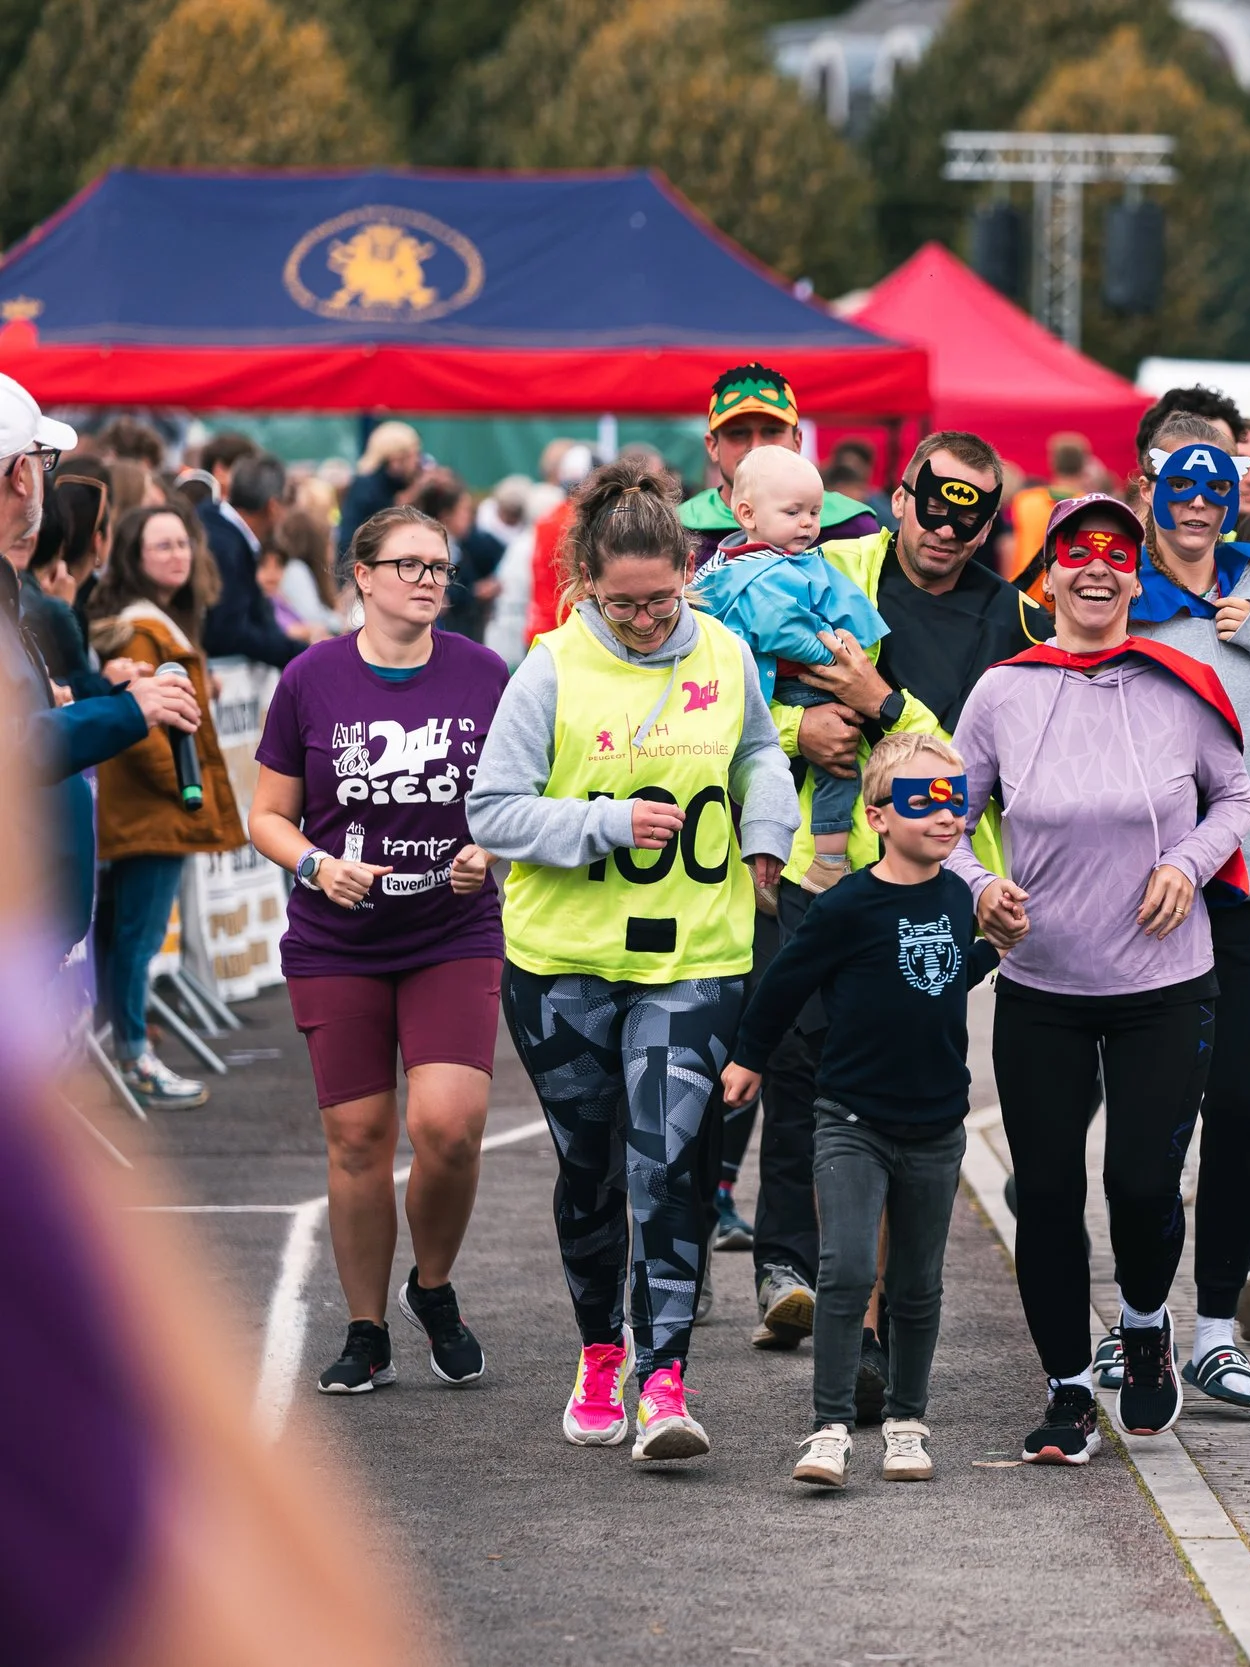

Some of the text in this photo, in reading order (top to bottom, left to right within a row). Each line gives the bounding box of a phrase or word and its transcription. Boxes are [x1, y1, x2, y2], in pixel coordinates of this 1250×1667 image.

[1182, 449, 1218, 474] A
[588, 753, 627, 762] PEUGEOT
[635, 740, 730, 759] Automobiles
[346, 821, 366, 836] Ath
[386, 869, 433, 891] l'avenir
